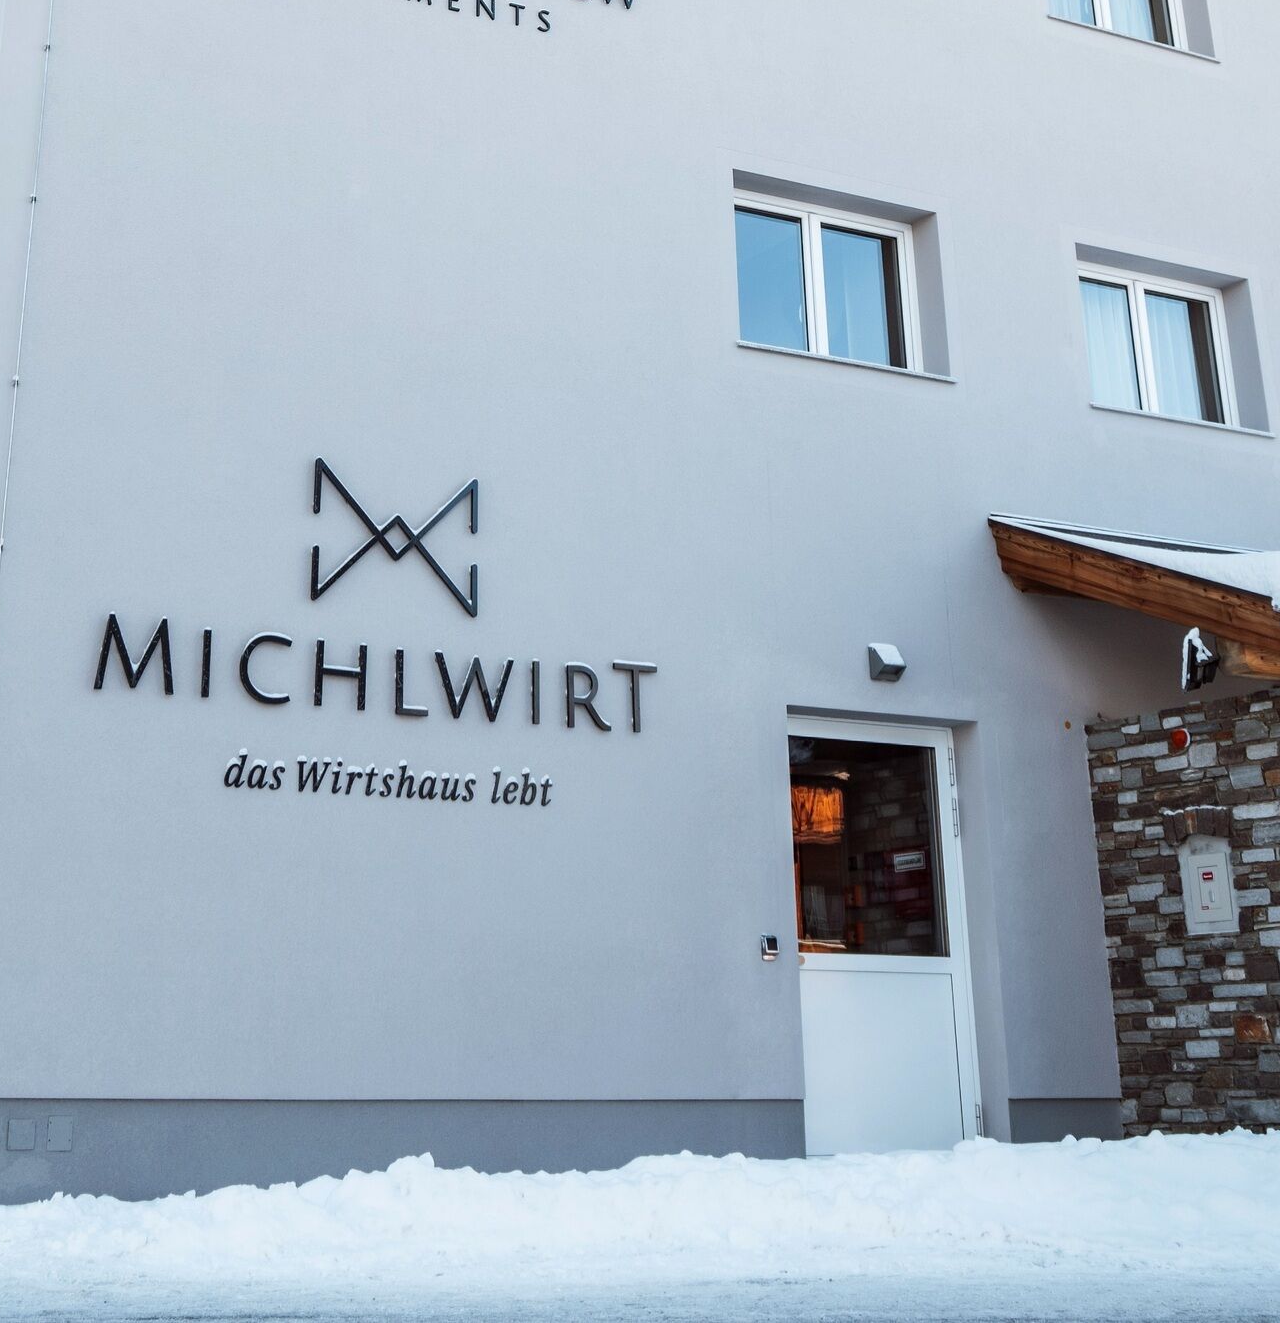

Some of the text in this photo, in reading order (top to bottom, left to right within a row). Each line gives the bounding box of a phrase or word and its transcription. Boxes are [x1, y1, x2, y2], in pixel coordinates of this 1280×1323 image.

[93, 611, 659, 734] MICHLWIRT
[223, 751, 554, 807] das Wirtshaus lebt
